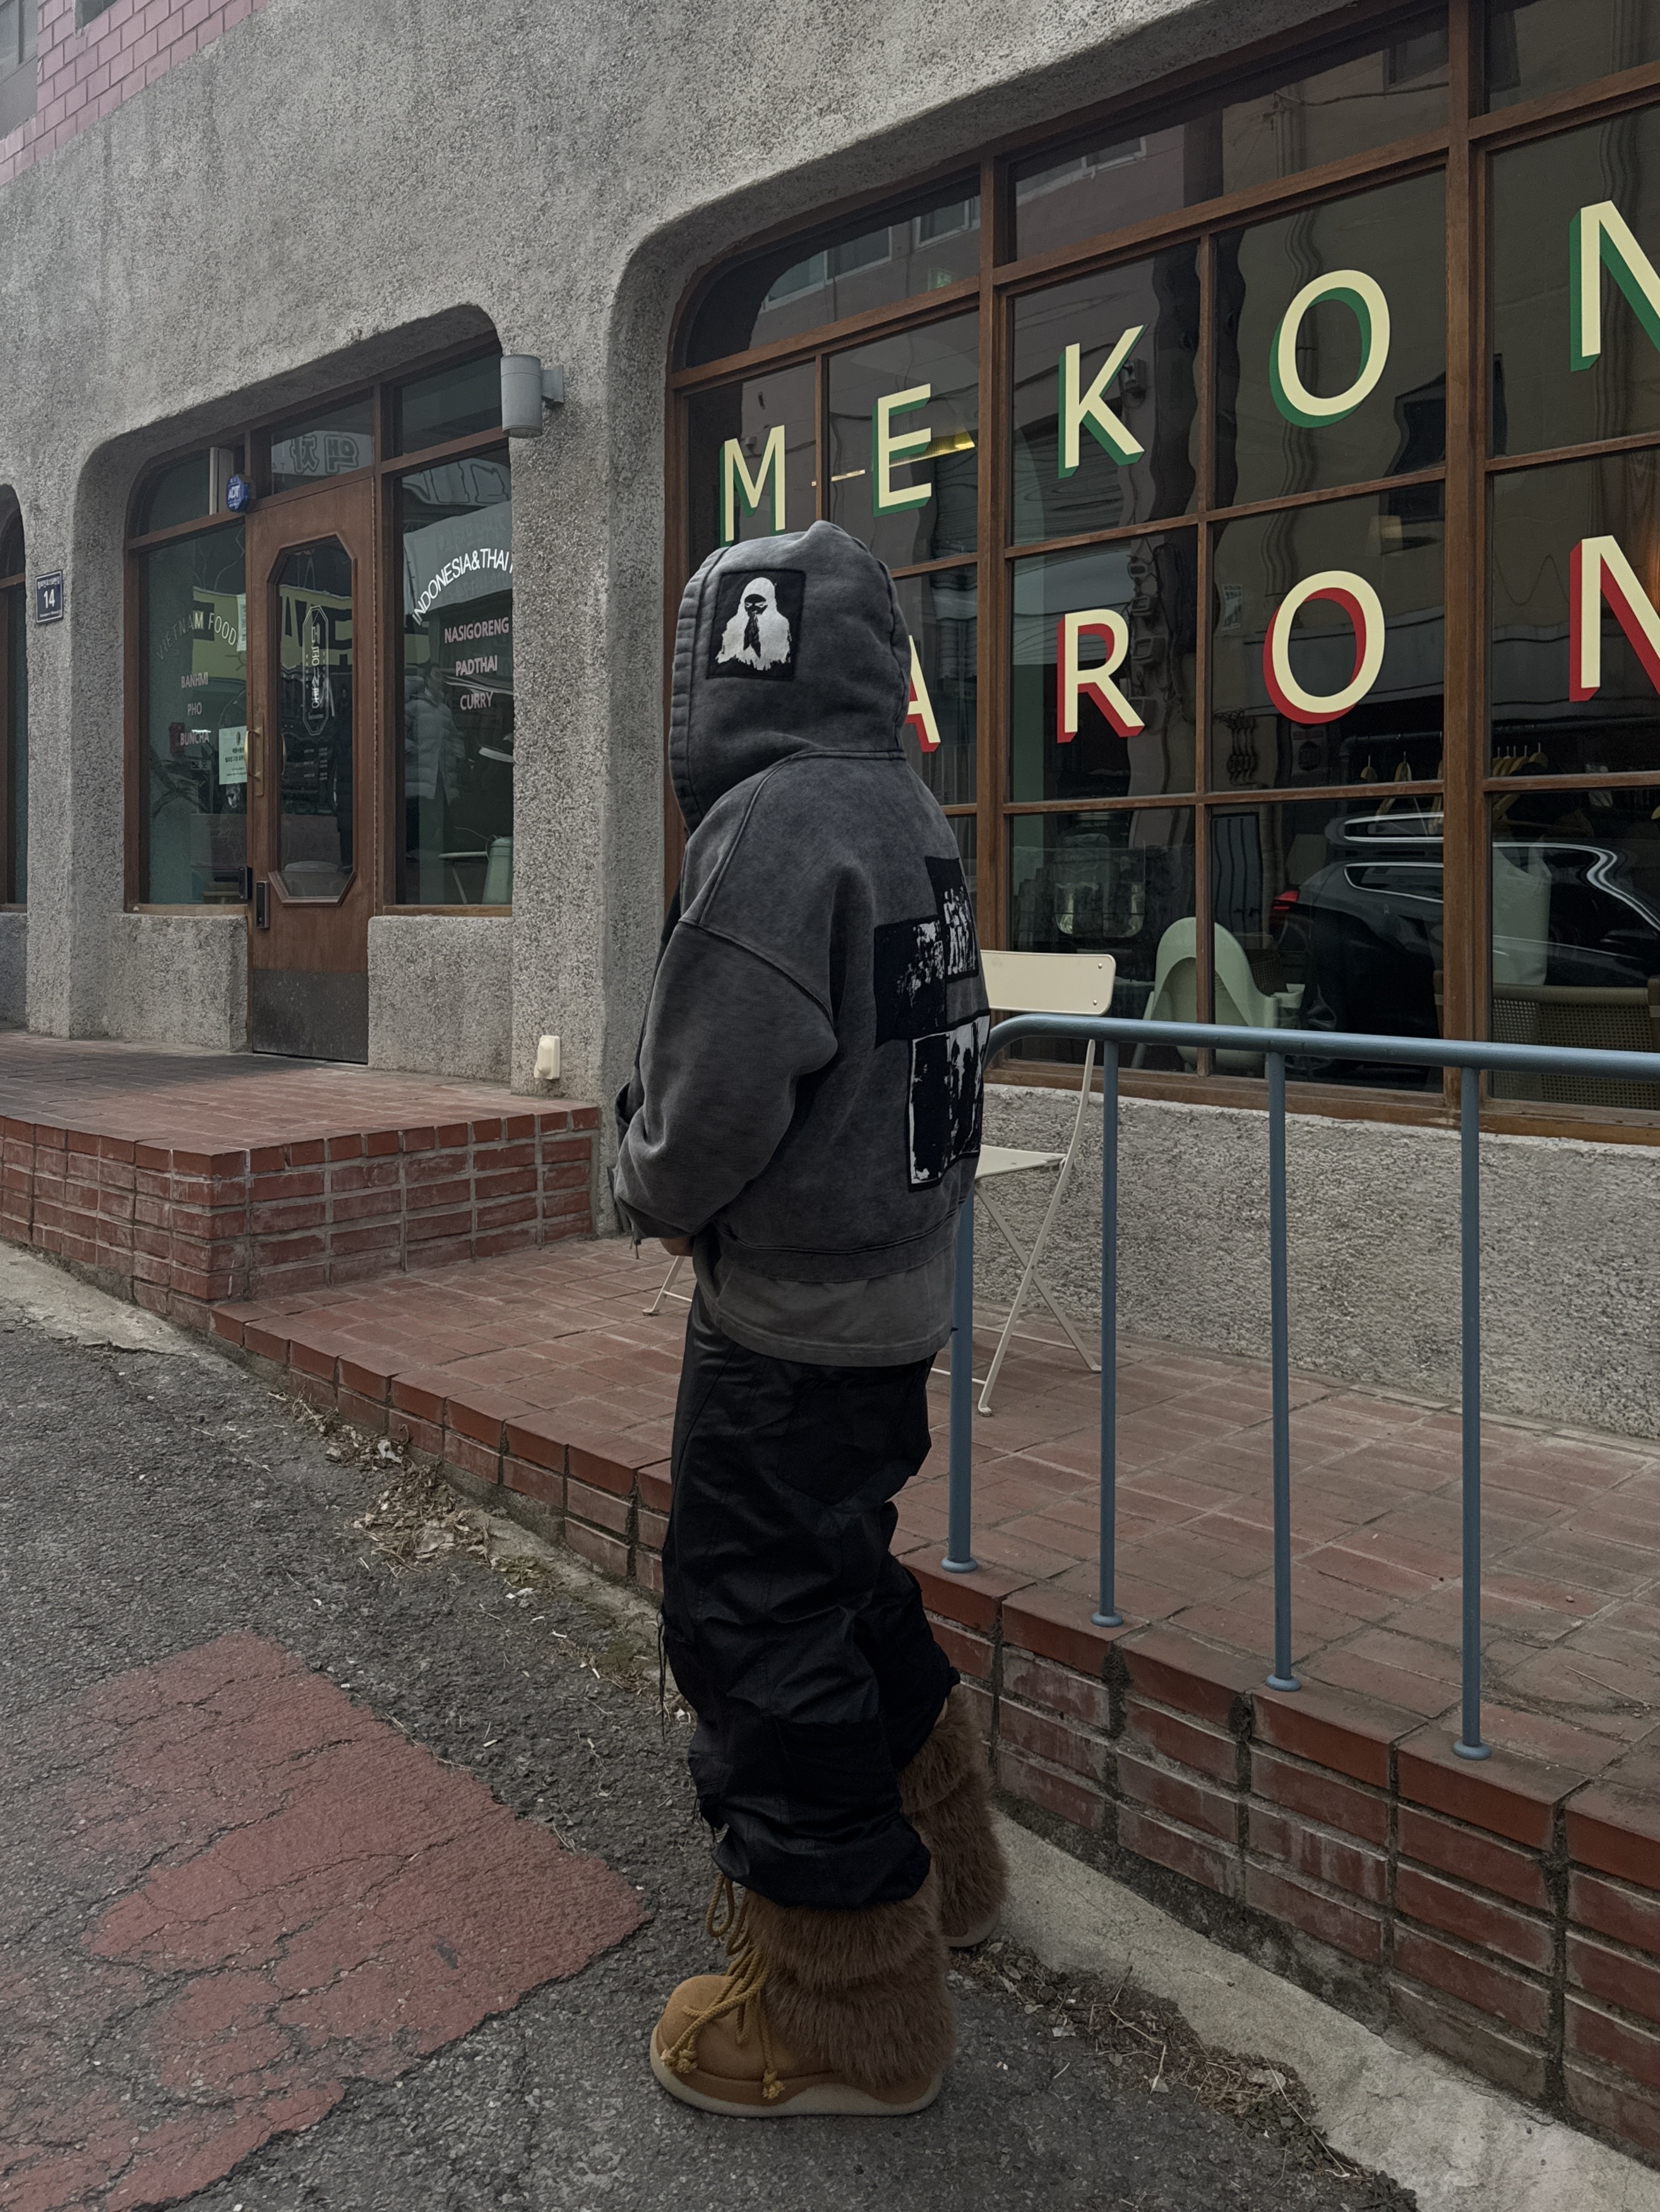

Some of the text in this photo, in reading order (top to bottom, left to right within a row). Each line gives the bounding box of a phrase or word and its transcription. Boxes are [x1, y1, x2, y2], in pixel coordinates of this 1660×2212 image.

[228, 485, 240, 500] ADT
[412, 548, 510, 626] INDONESIA&THAI
[44, 589, 55, 609] 14
[156, 611, 204, 660] VIETNAM
[208, 612, 237, 645] FOOD
[445, 617, 509, 643] NASIGORENG
[455, 655, 498, 676] PADTHAI
[181, 672, 209, 689] BANHMI
[188, 702, 202, 716] PHO
[460, 691, 494, 710] CURRY
[180, 732, 210, 746] BUNCHA
